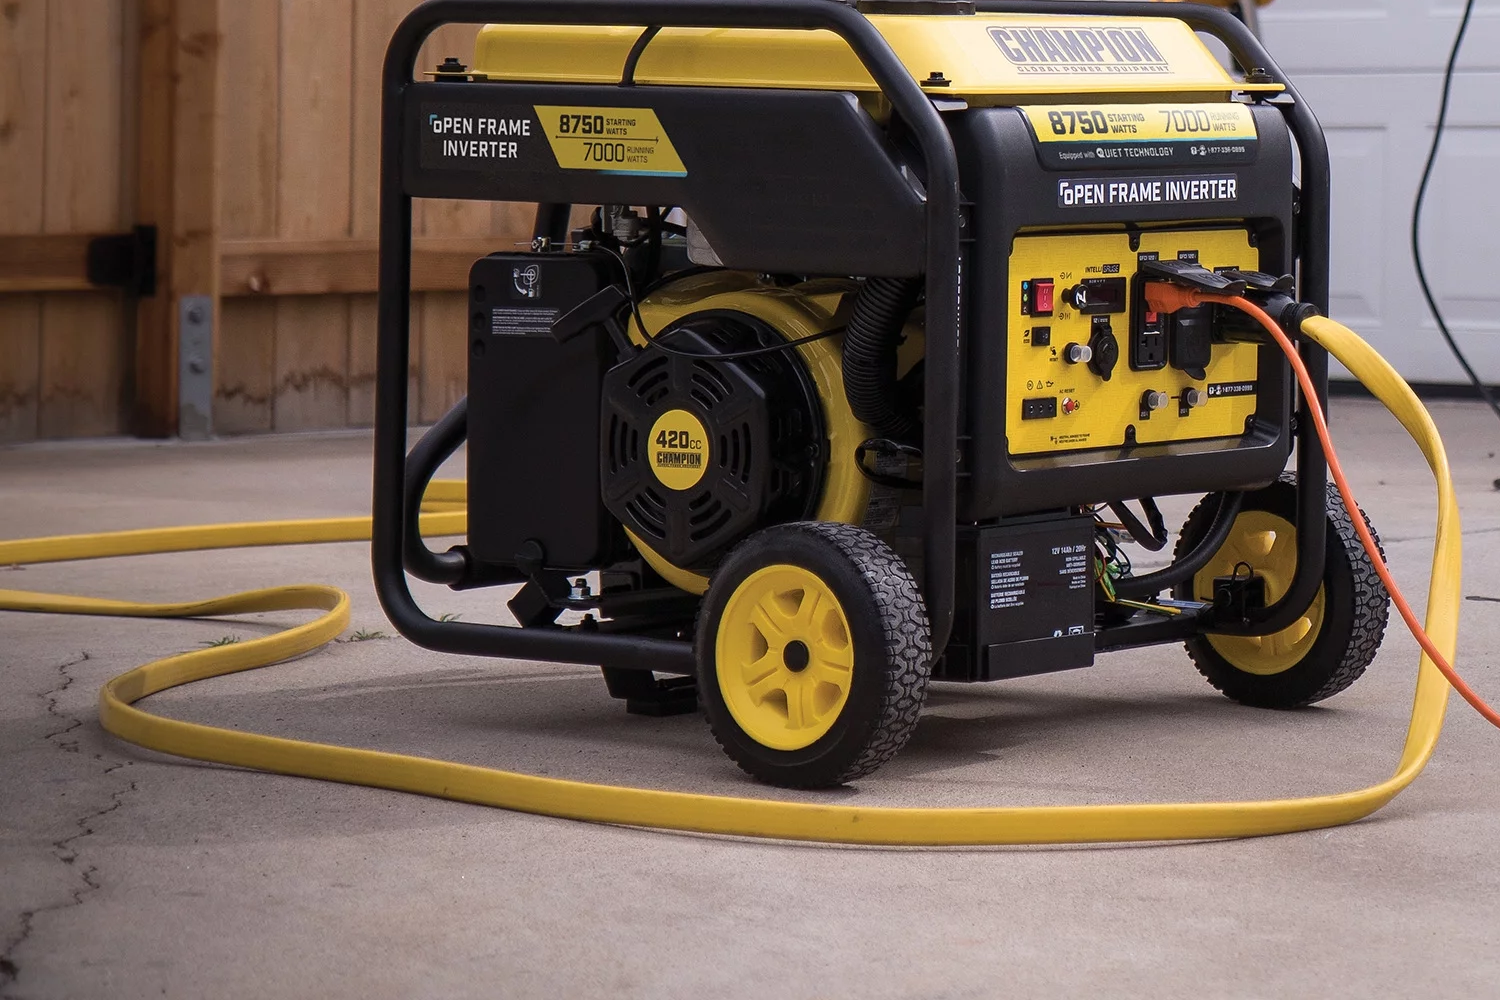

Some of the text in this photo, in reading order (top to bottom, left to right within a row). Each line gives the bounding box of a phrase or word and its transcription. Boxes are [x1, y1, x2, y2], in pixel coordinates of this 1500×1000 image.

[987, 27, 1167, 64] CHAMPION
[1108, 65, 1170, 73] EQUIPMENT
[478, 118, 531, 136] FRAME
[559, 115, 636, 134] 8750 STARTING
[1048, 111, 1145, 135] 8750 STARTING
[1111, 124, 1137, 134] WATTS
[1159, 110, 1241, 133] 7000 RUNNING
[1213, 122, 1237, 132] WATTS
[606, 127, 627, 136] WATTS
[443, 140, 518, 159] INVERTER
[583, 143, 655, 162] 7000 RUNNING
[1059, 147, 1174, 160] Equipped with QUIET TECHNOLOGY
[626, 155, 648, 164] WATTS
[1109, 181, 1161, 203] FRAME
[1165, 179, 1236, 201] INVERTER
[657, 452, 701, 465] CHAMPION
